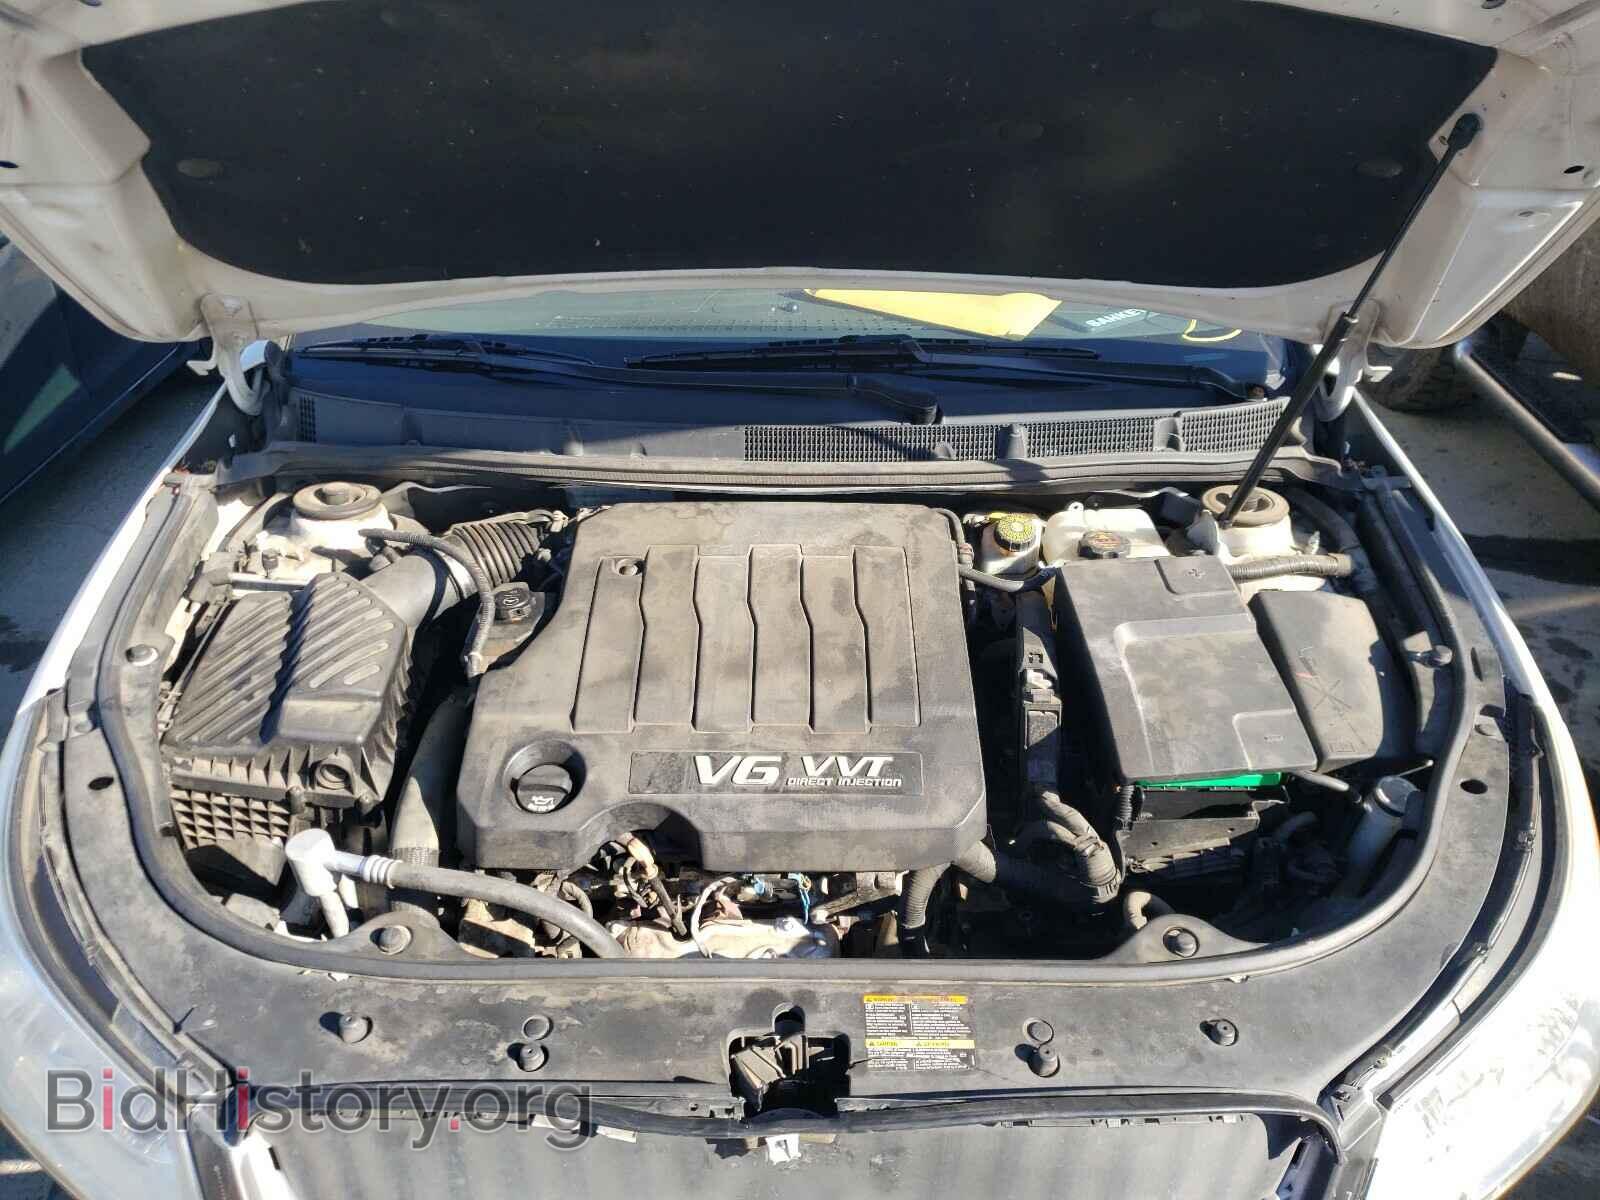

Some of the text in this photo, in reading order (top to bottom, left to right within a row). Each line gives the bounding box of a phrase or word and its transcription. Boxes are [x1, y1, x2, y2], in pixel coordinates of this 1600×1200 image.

[694, 755, 894, 786] V6 VVT
[787, 777, 903, 788] DIRECT INJECTION
